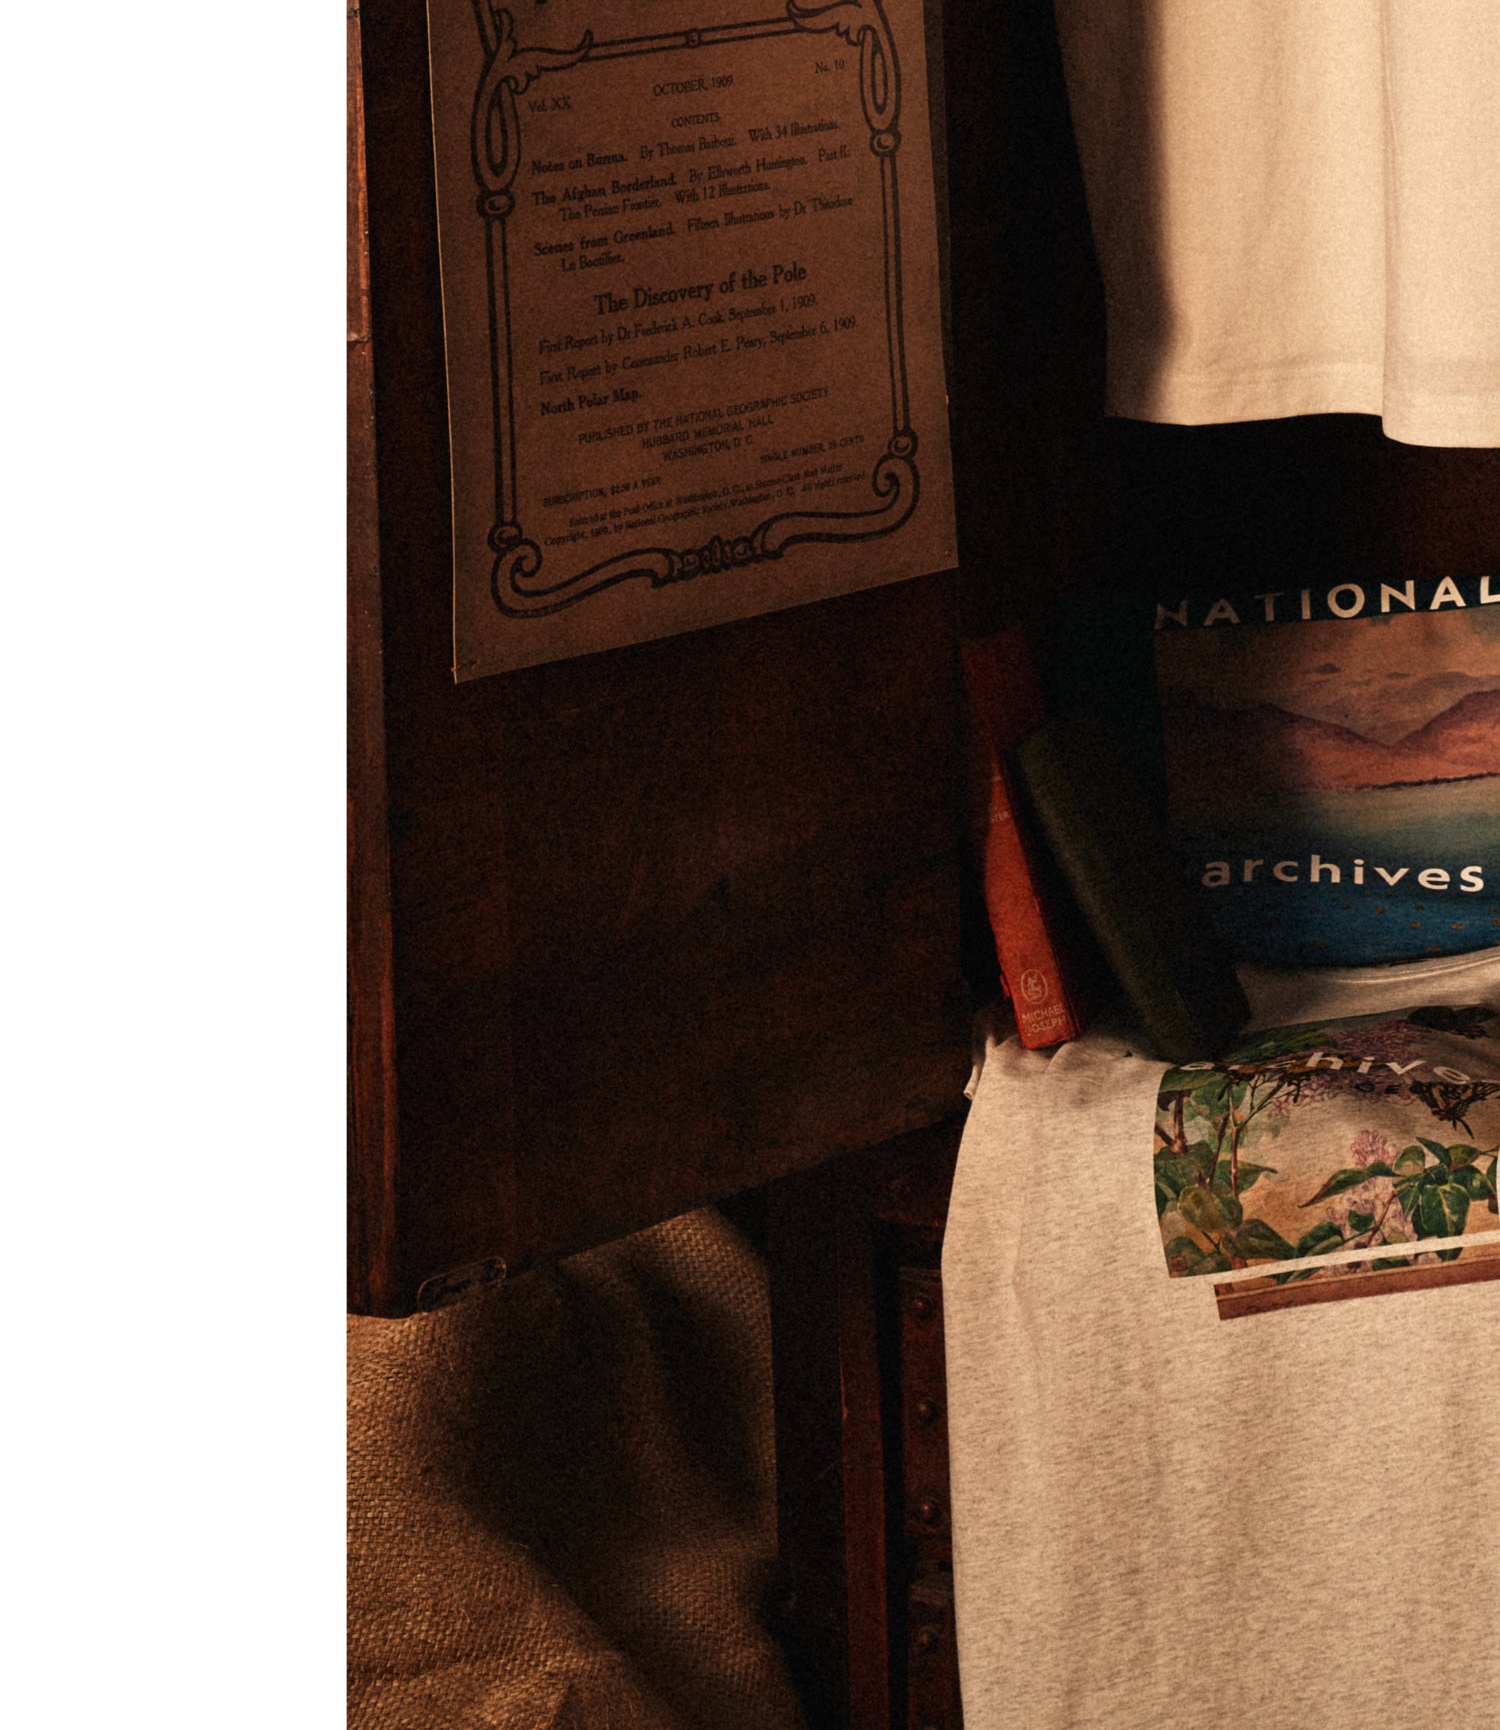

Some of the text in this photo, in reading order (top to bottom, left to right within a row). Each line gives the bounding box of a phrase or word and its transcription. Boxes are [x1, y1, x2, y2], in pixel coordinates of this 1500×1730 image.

[671, 112, 720, 128] CONTENTS
[531, 160, 564, 175] Notes
[568, 159, 583, 169] on
[640, 145, 653, 161] By
[657, 142, 695, 157] Thomas
[748, 128, 772, 143] With
[775, 126, 787, 139] 34
[532, 190, 556, 206] The
[562, 185, 606, 202] Afghan
[611, 173, 677, 194] Borderland.
[689, 169, 703, 184] By
[708, 161, 751, 180] Ellsworth
[818, 148, 837, 163] Part
[558, 207, 580, 221] The
[584, 202, 619, 218] Persian
[674, 187, 699, 203] With
[703, 185, 715, 200] 12
[534, 194, 854, 257] Scenes from Greenland. Fifteen Illustrations by Dr Theodore
[594, 261, 807, 315] The Discovery of the Pole
[539, 339, 560, 355] First
[565, 334, 598, 351] Report
[601, 329, 614, 346] by
[617, 326, 631, 341] Dr
[634, 318, 678, 338] Frederick
[729, 302, 776, 323] September
[540, 371, 562, 385] First
[567, 365, 601, 382] Report
[604, 359, 617, 376] by
[622, 350, 679, 370] Commander
[683, 344, 718, 360] Robert
[736, 335, 766, 351] Peary,
[770, 325, 816, 345] September
[541, 388, 642, 416] North Polar Map.
[578, 387, 829, 445] PUBLISHED BY THE NATIONAL GEOGRAPHIC SOCIETY
[642, 415, 774, 449] HUBBARD MEMORIAL HALL
[839, 435, 865, 447] CENTS
[641, 476, 662, 487] YEAR
[1200, 854, 1485, 893] archives
[1021, 1002, 1066, 1024] MICHAEL
[1027, 1015, 1067, 1037] JOSEPH
